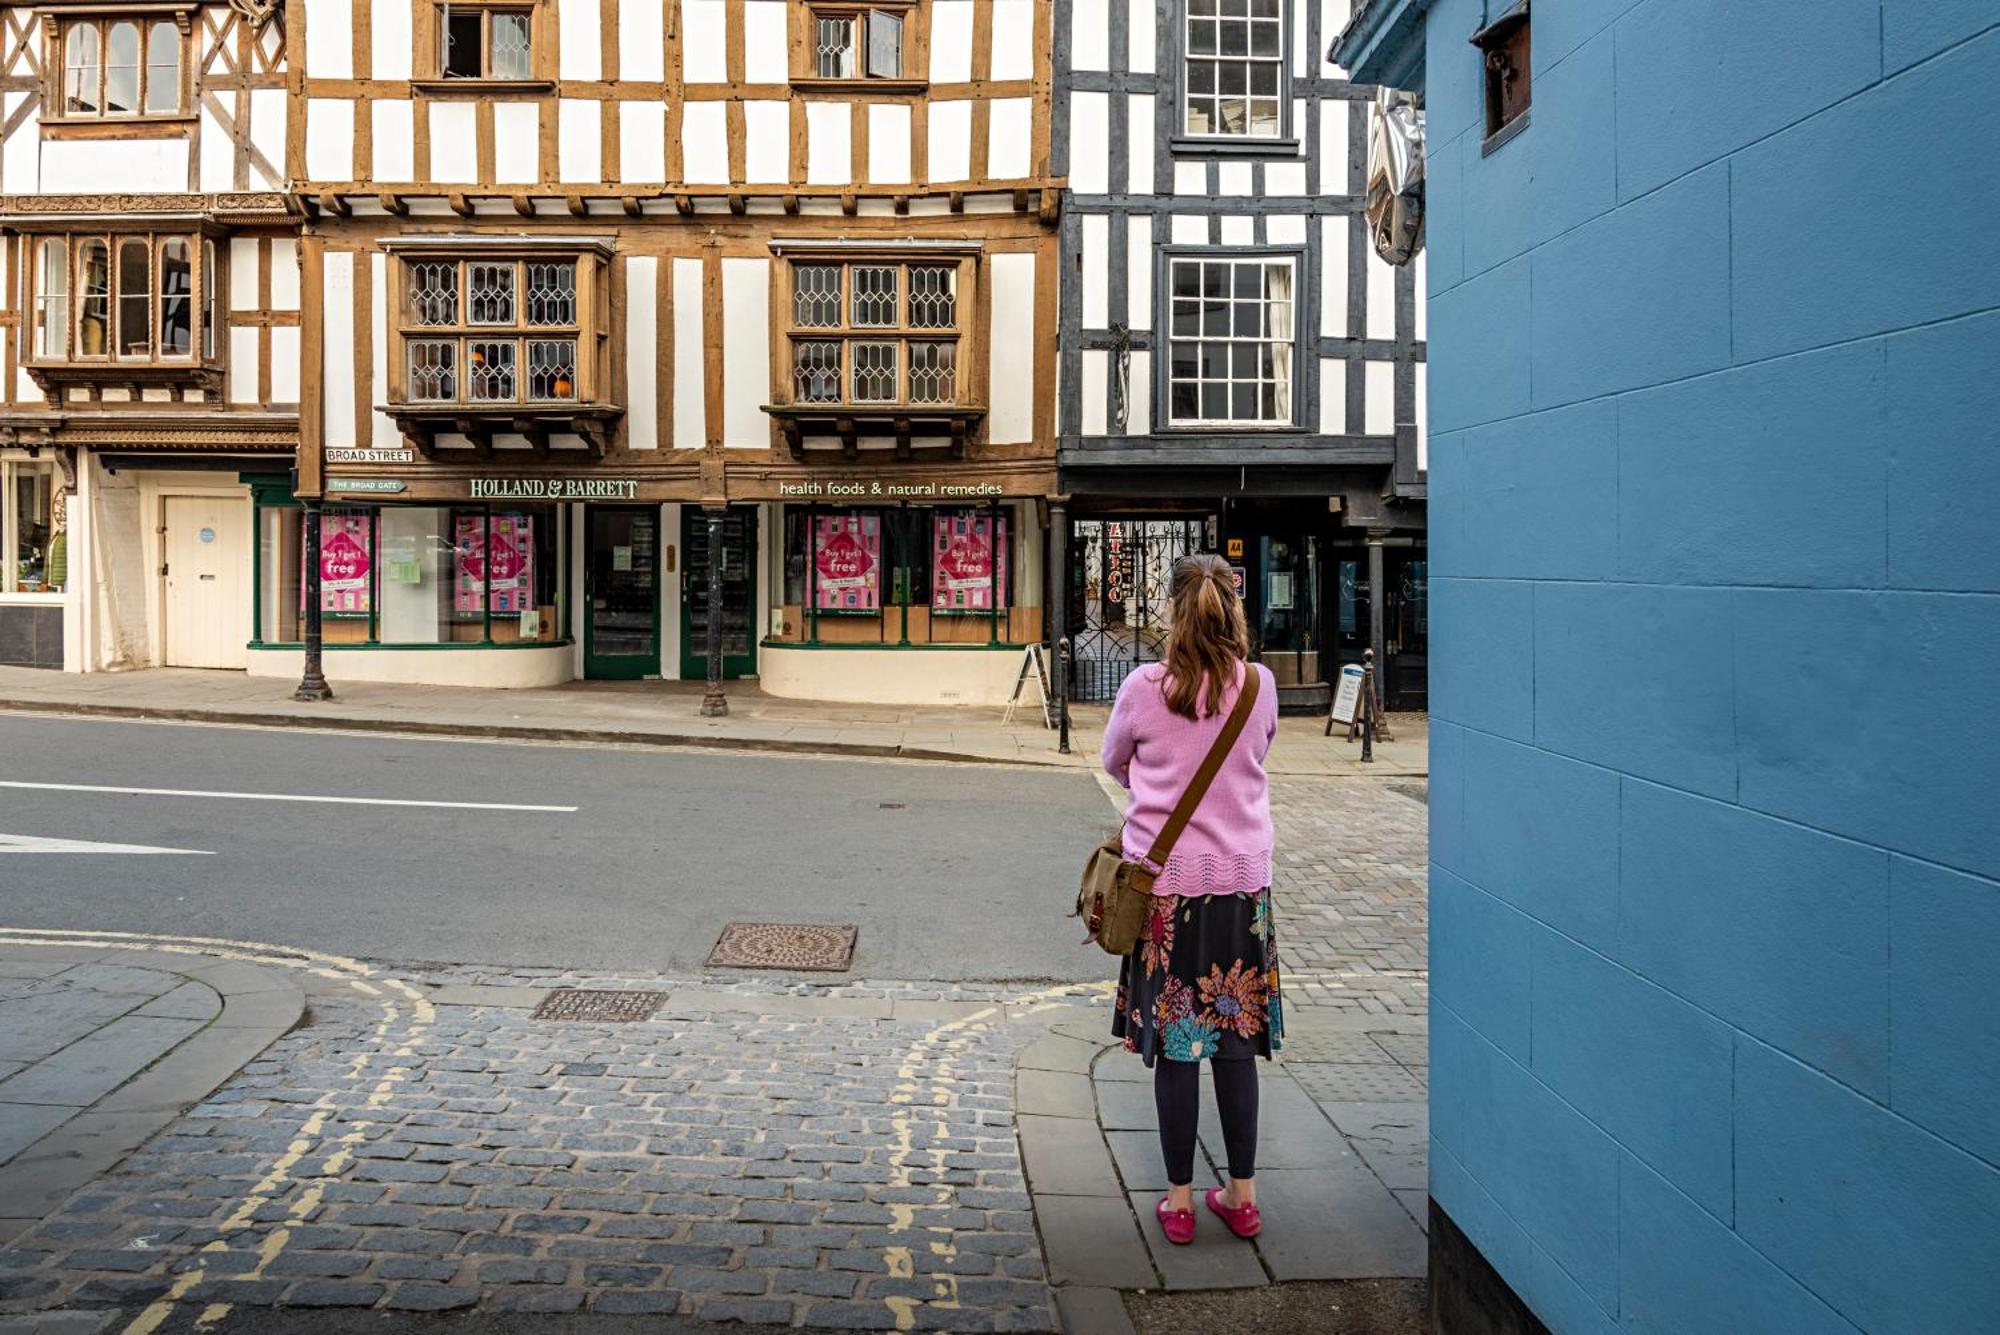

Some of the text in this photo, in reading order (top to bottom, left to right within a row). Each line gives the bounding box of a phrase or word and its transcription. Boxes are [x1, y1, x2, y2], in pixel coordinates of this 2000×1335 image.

[328, 450, 412, 460] BROAD STREET
[379, 482, 398, 490] GATE
[470, 479, 638, 499] HOLLAND & BARRETT
[779, 482, 1003, 495] health foods & natural remedies
[1230, 543, 1241, 552] AA
[322, 550, 337, 560] Buy
[343, 551, 356, 561] get
[825, 549, 839, 560] Buy
[846, 550, 858, 560] get
[952, 549, 965, 560] Buy
[327, 560, 355, 573] free
[830, 560, 857, 572] free
[956, 560, 982, 572] free
